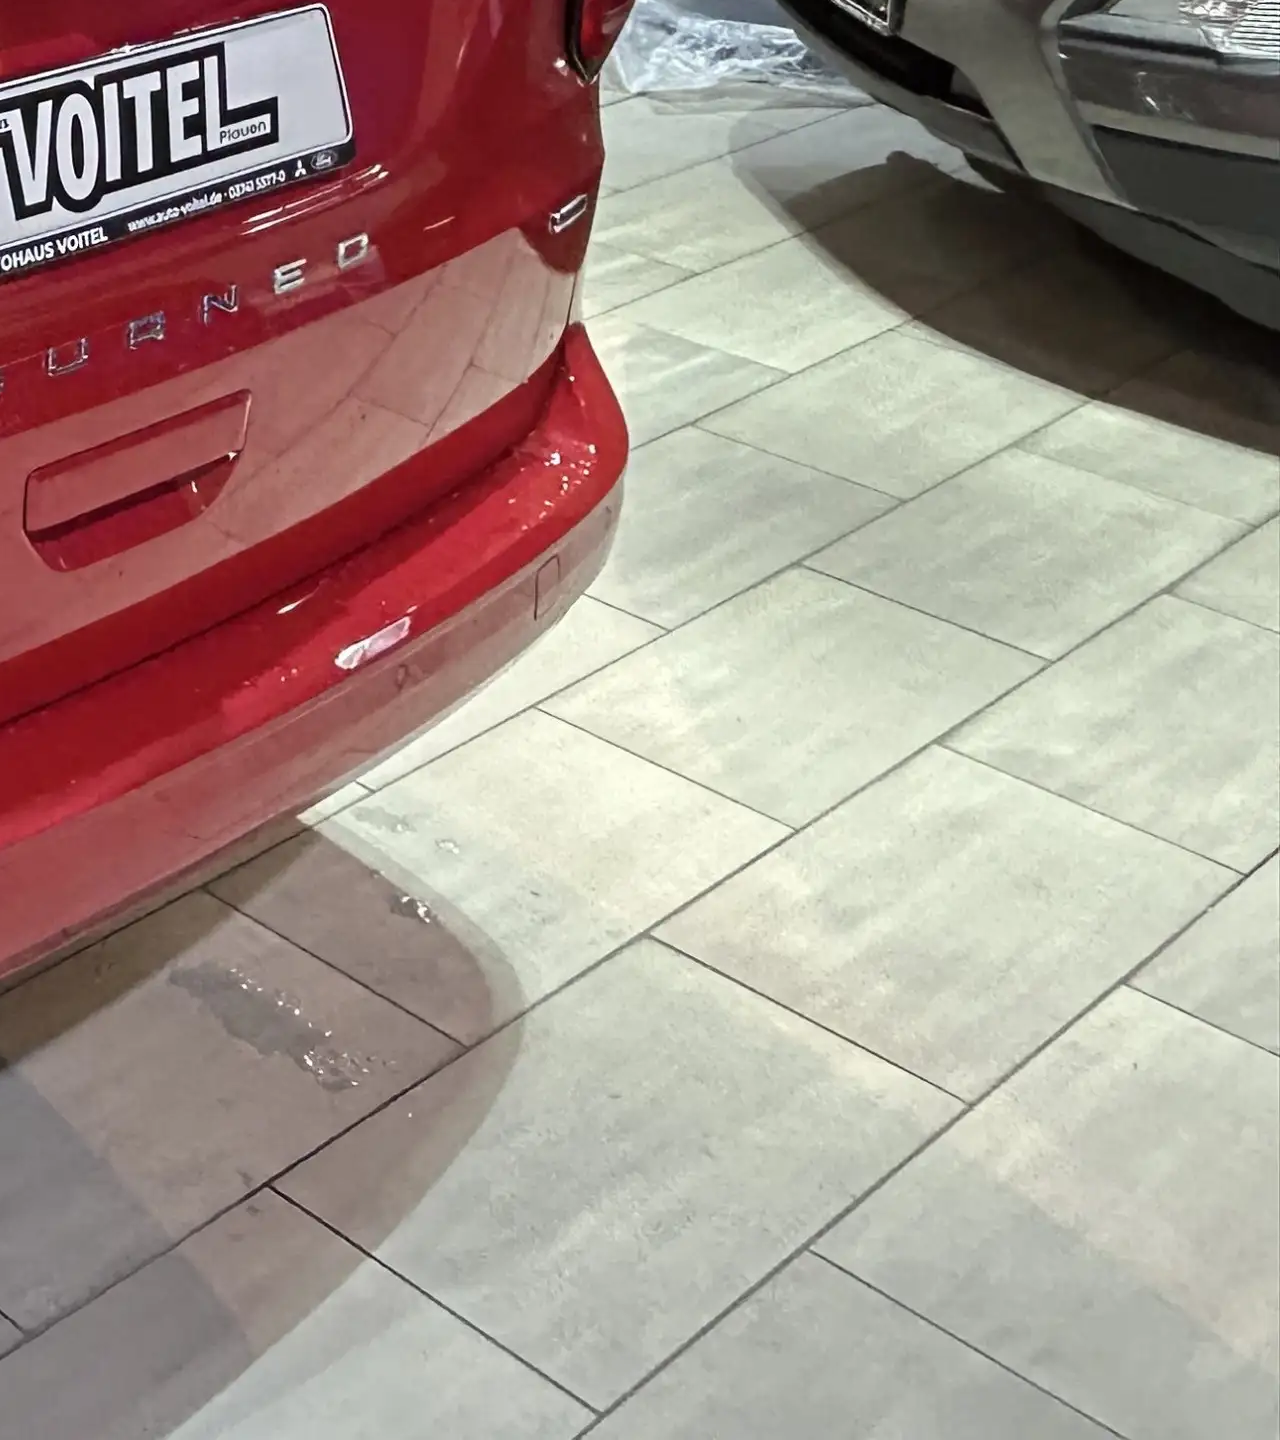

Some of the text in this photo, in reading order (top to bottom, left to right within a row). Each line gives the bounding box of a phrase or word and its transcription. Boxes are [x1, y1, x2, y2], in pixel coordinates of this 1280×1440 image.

[6, 52, 230, 210] VOITEL
[219, 120, 268, 145] Plauen
[56, 225, 108, 256] VOITEL
